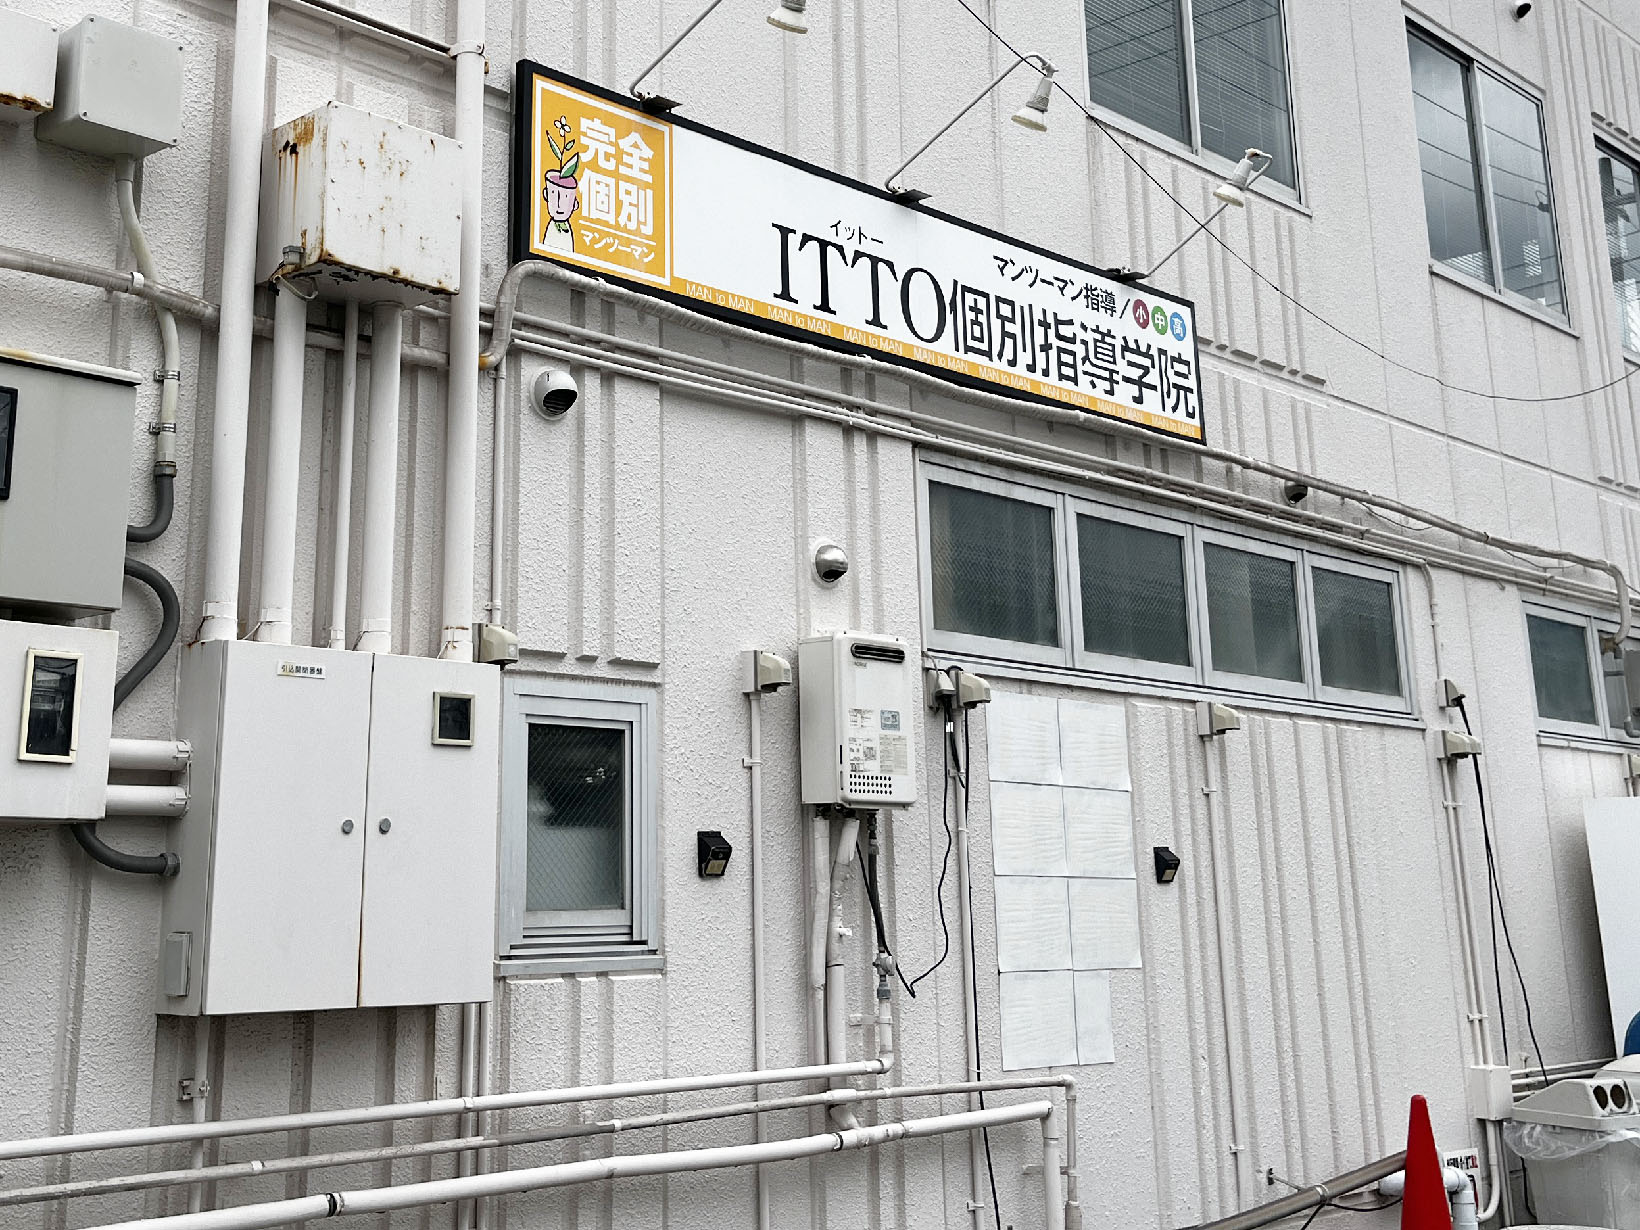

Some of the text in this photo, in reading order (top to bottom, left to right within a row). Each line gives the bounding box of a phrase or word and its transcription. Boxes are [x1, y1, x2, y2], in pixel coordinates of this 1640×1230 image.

[579, 116, 654, 184] 完全
[578, 168, 653, 236] 個別
[580, 229, 656, 263] マンツーマン
[830, 220, 884, 245] イットー
[686, 282, 754, 314] MAN to MAN
[768, 305, 831, 336] MAN to MAN
[843, 327, 902, 355] MAN to MAN
[913, 346, 968, 372] MAN to MAN
[978, 366, 1031, 390] MAN to MAN
[1040, 383, 1089, 407] MAN to MAN
[1097, 399, 1145, 421] MAN to MAN
